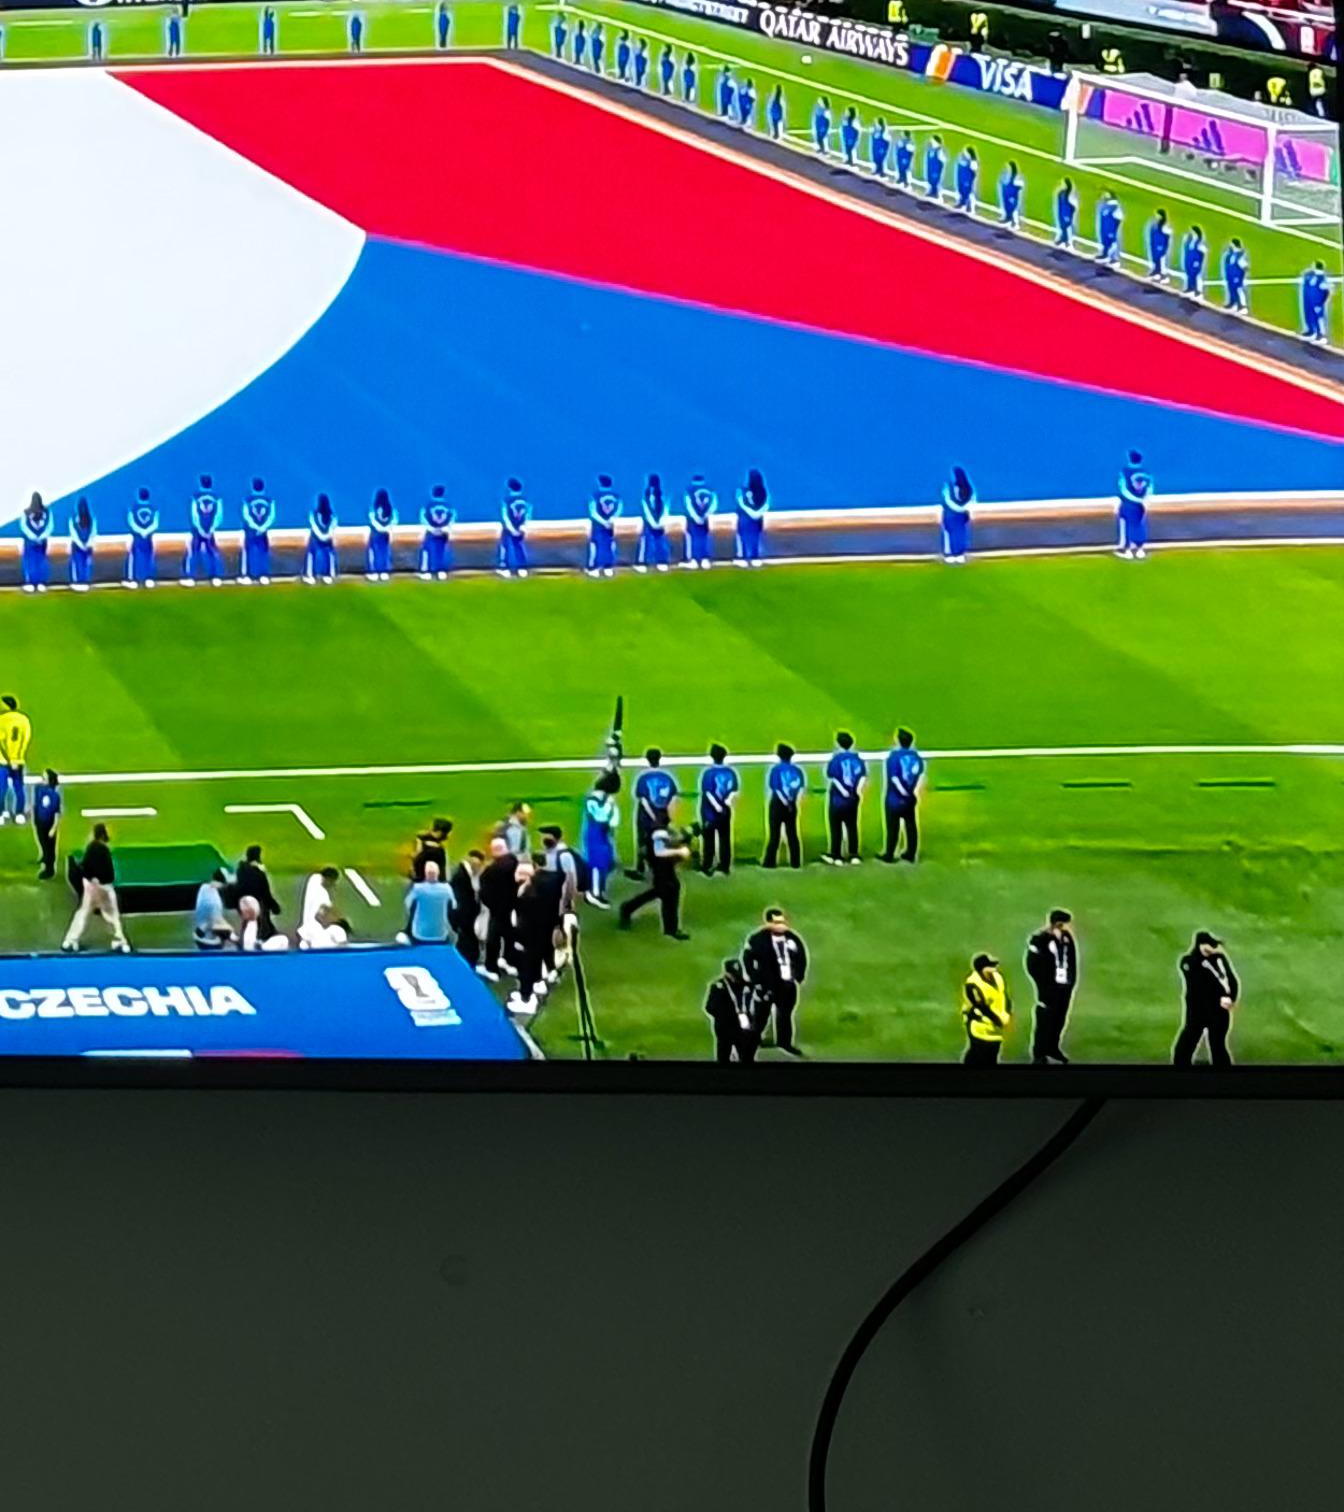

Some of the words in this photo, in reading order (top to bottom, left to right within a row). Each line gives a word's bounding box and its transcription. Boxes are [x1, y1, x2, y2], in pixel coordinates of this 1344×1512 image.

[760, 10, 821, 46] QATAR
[826, 27, 909, 67] AIRWAYS
[970, 52, 1034, 101] VISA
